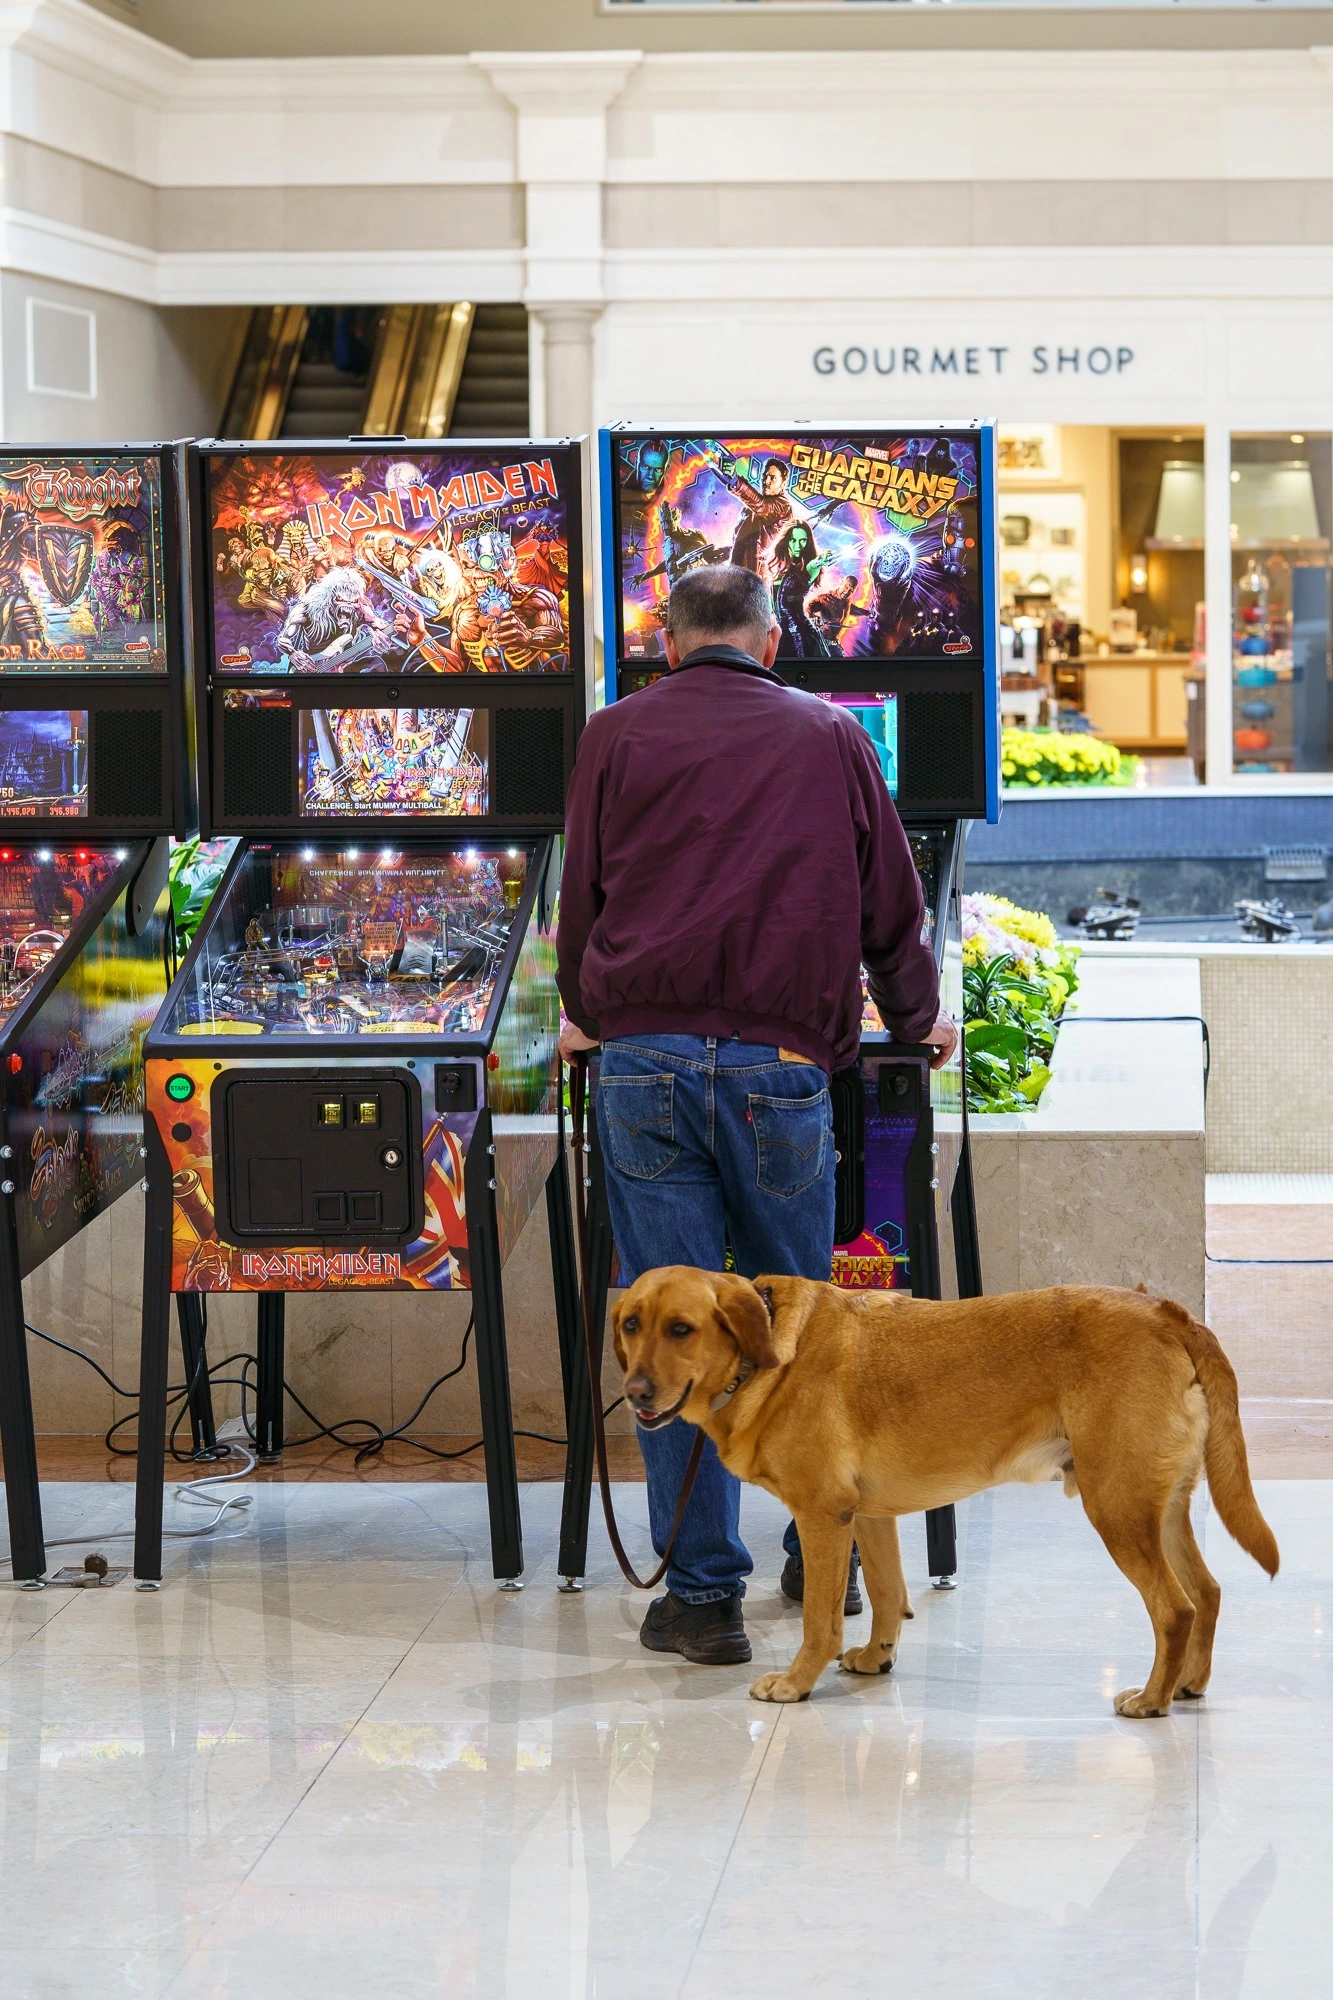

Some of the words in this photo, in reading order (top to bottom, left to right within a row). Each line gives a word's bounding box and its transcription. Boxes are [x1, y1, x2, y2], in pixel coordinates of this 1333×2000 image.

[812, 346, 1009, 375] GOURMET
[1031, 346, 1135, 375] SHOP
[865, 446, 890, 461] MARVEL
[790, 444, 959, 500] GUARDIANS
[807, 471, 825, 482] OF
[14, 465, 141, 520] Knight
[799, 480, 822, 494] THE
[306, 488, 407, 542] IRON
[404, 458, 560, 522] MAIDEN
[822, 473, 948, 519] GALAXY
[452, 507, 500, 526] LEGACY
[511, 497, 551, 515] BEAST
[405, 767, 435, 778] IRON
[437, 767, 482, 778] MAIDEN
[451, 781, 482, 789] BEAST
[305, 802, 353, 810] CHALLENGE:
[354, 802, 372, 810] Start
[372, 802, 401, 810] MUMMY
[402, 802, 443, 810] MULTIBALL
[242, 1254, 303, 1282] IRON
[305, 1253, 401, 1282] MAIDEN
[832, 1257, 895, 1272] RDIANS
[328, 1278, 361, 1286] LEGACY
[369, 1277, 396, 1285] BEAST
[829, 1271, 892, 1286] ALAXY
